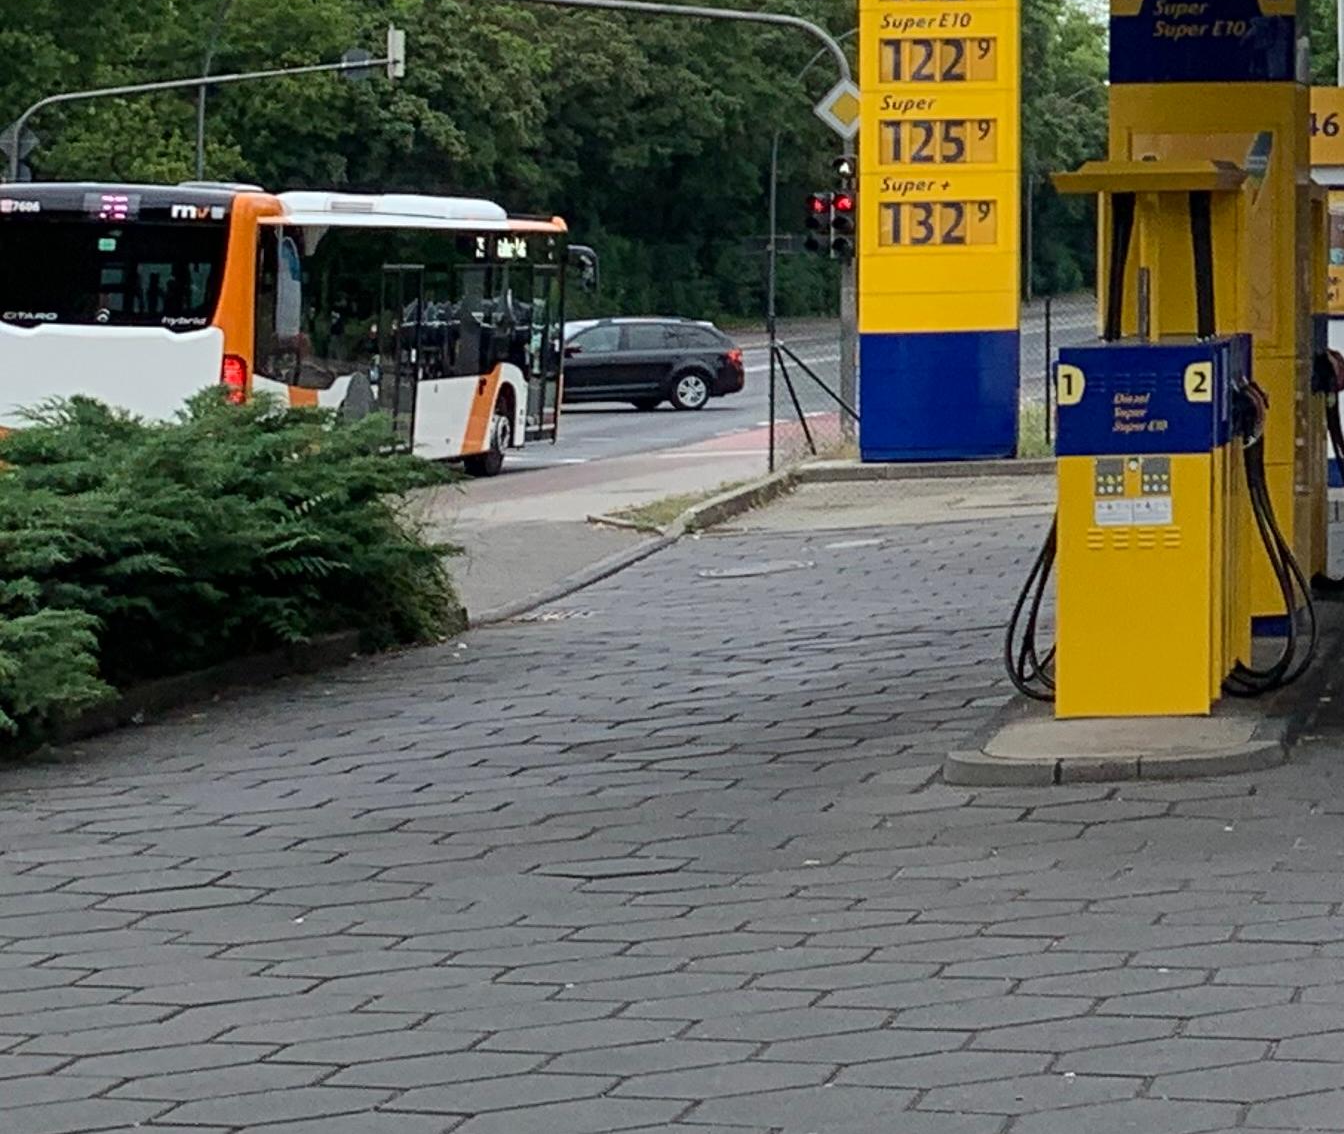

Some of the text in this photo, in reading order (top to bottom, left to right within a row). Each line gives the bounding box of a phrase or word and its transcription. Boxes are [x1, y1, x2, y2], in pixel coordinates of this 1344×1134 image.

[879, 13, 972, 31] Super E10
[1153, 20, 1247, 42] Super E10
[879, 96, 936, 113] Super
[879, 177, 936, 195] Super
[1062, 373, 1073, 396] 1
[1192, 371, 1208, 393] 2
